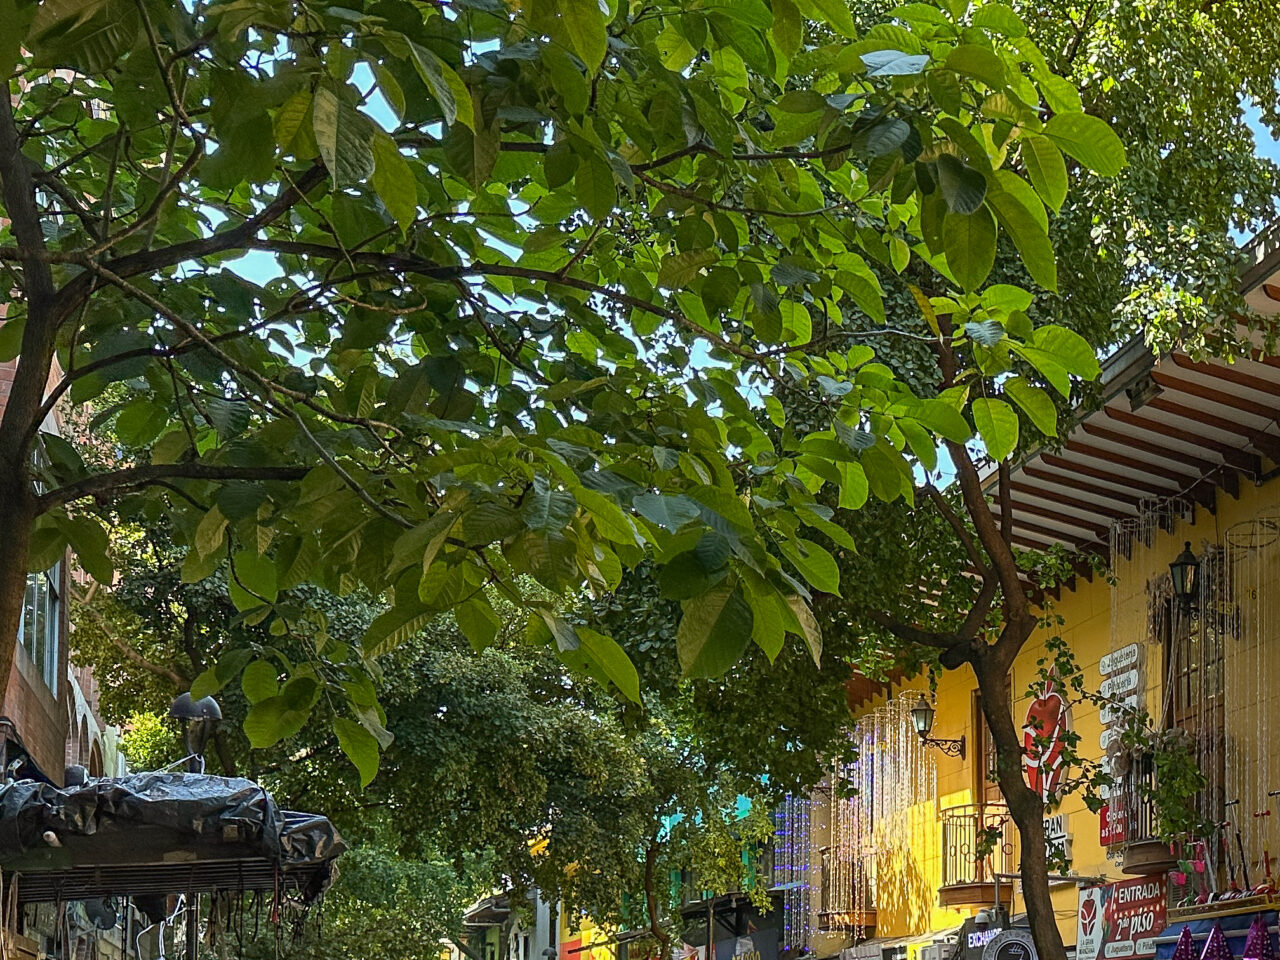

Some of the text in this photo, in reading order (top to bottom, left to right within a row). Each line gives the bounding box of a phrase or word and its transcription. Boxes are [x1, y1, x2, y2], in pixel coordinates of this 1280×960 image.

[1043, 814, 1063, 838] RAN
[1118, 881, 1161, 904] ENTRADA
[1129, 906, 1155, 941] piso
